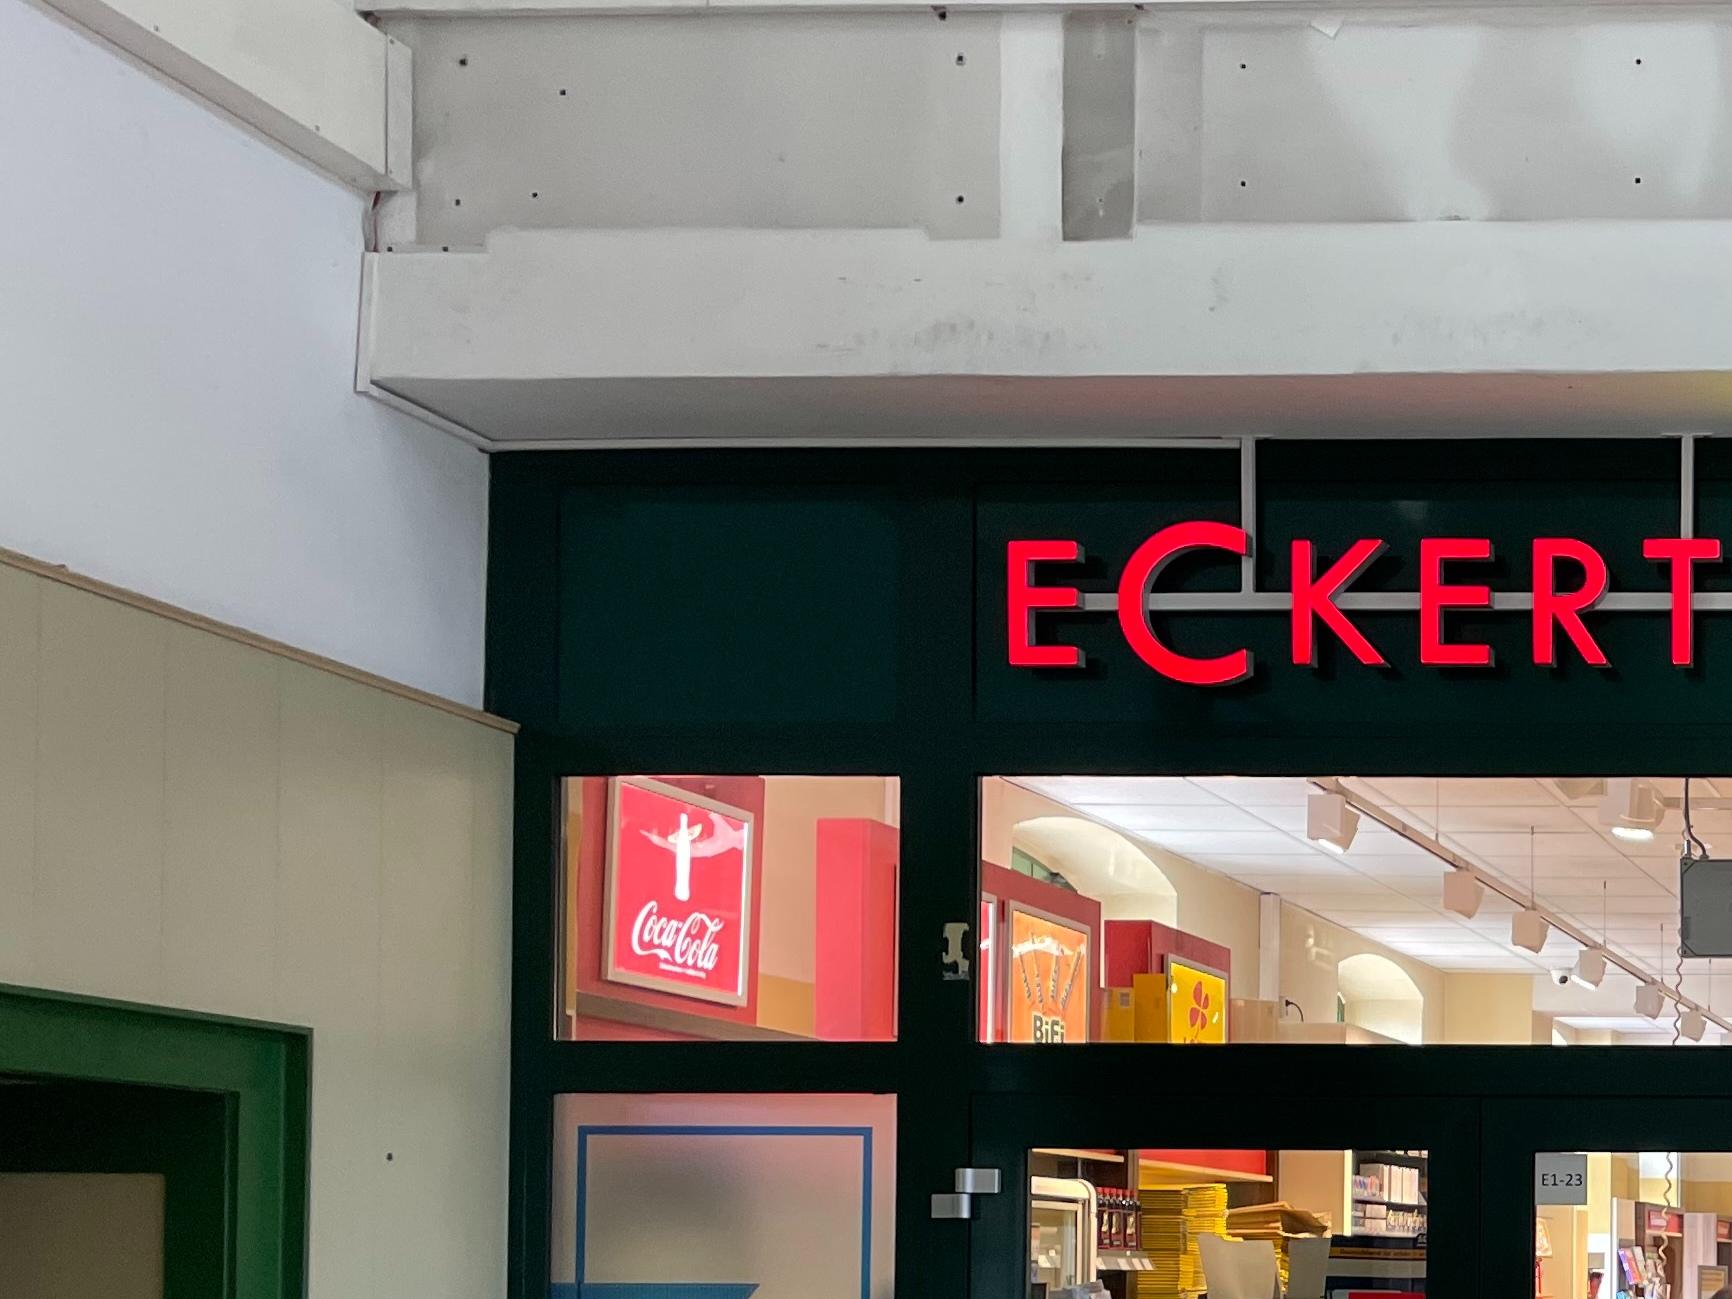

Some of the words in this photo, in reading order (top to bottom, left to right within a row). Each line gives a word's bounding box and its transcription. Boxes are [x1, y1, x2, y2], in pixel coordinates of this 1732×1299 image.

[1007, 521, 1721, 684] ECKERT
[631, 901, 724, 970] Coca-Cola
[1033, 1015, 1064, 1044] BiFi
[1541, 1173, 1583, 1187] E1-23
